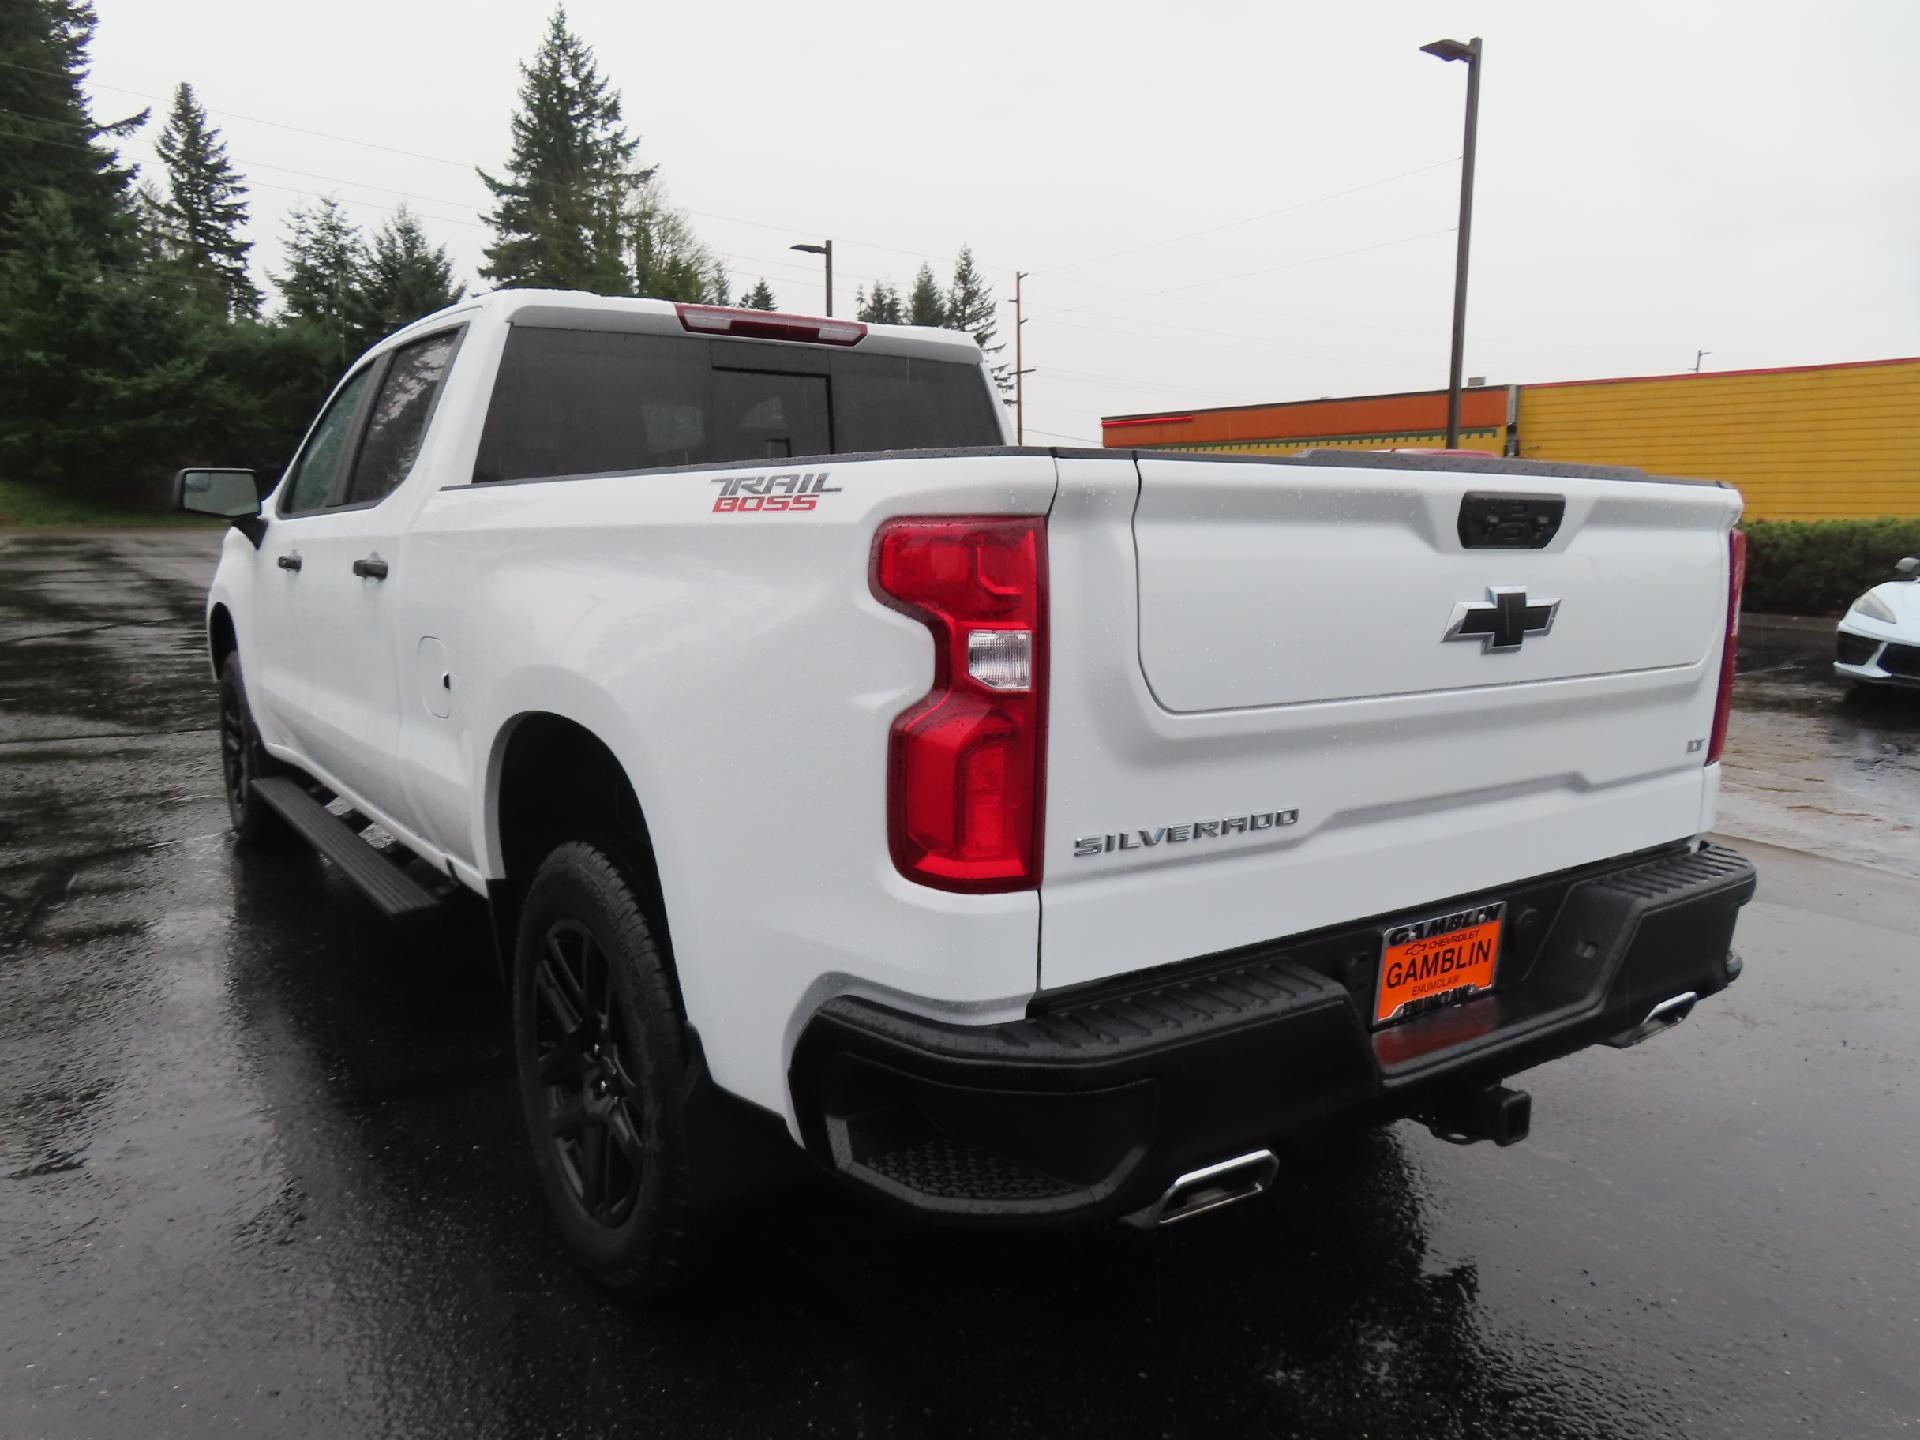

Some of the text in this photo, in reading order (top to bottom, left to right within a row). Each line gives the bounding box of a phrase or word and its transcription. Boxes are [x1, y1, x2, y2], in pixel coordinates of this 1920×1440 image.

[711, 472, 842, 496] TRAIL
[712, 494, 819, 512] BOSS
[1073, 808, 1299, 857] SILVERADO
[1428, 930, 1480, 950] CHEVROLET
[1386, 938, 1492, 989] GAMBLIN
